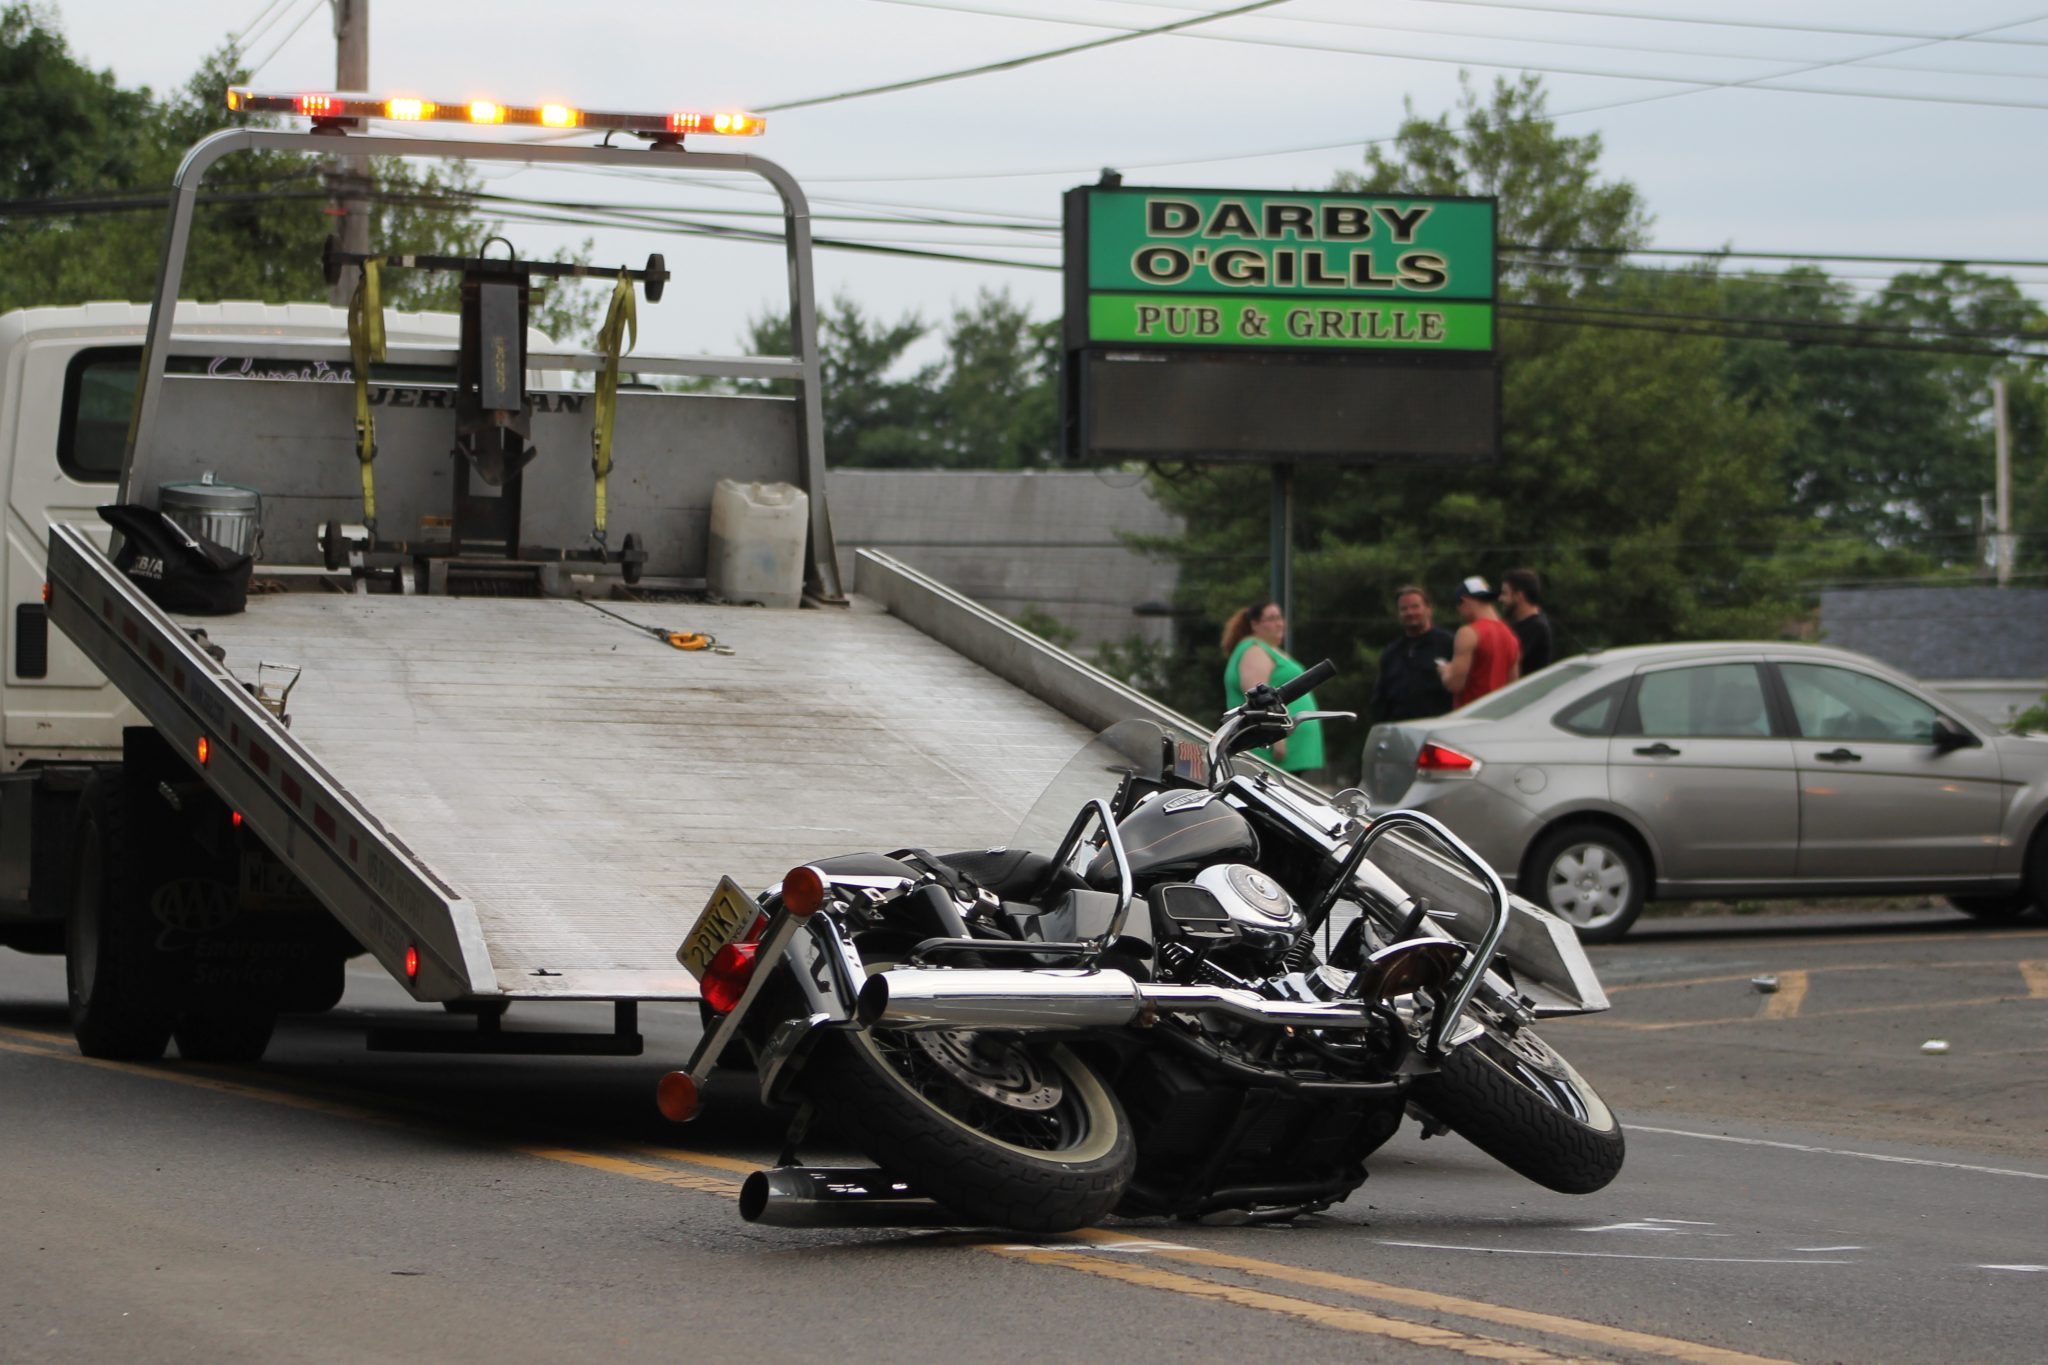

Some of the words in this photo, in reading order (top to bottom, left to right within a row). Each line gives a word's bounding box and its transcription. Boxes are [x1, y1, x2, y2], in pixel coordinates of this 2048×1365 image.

[1146, 197, 1433, 246] DARBY
[1132, 244, 1449, 291] O'GILLS
[1137, 304, 1221, 336] PUB
[1239, 308, 1268, 338] &
[1287, 309, 1445, 341] GRILLE
[158, 878, 234, 930] AAA
[691, 895, 739, 968] 2PVK7
